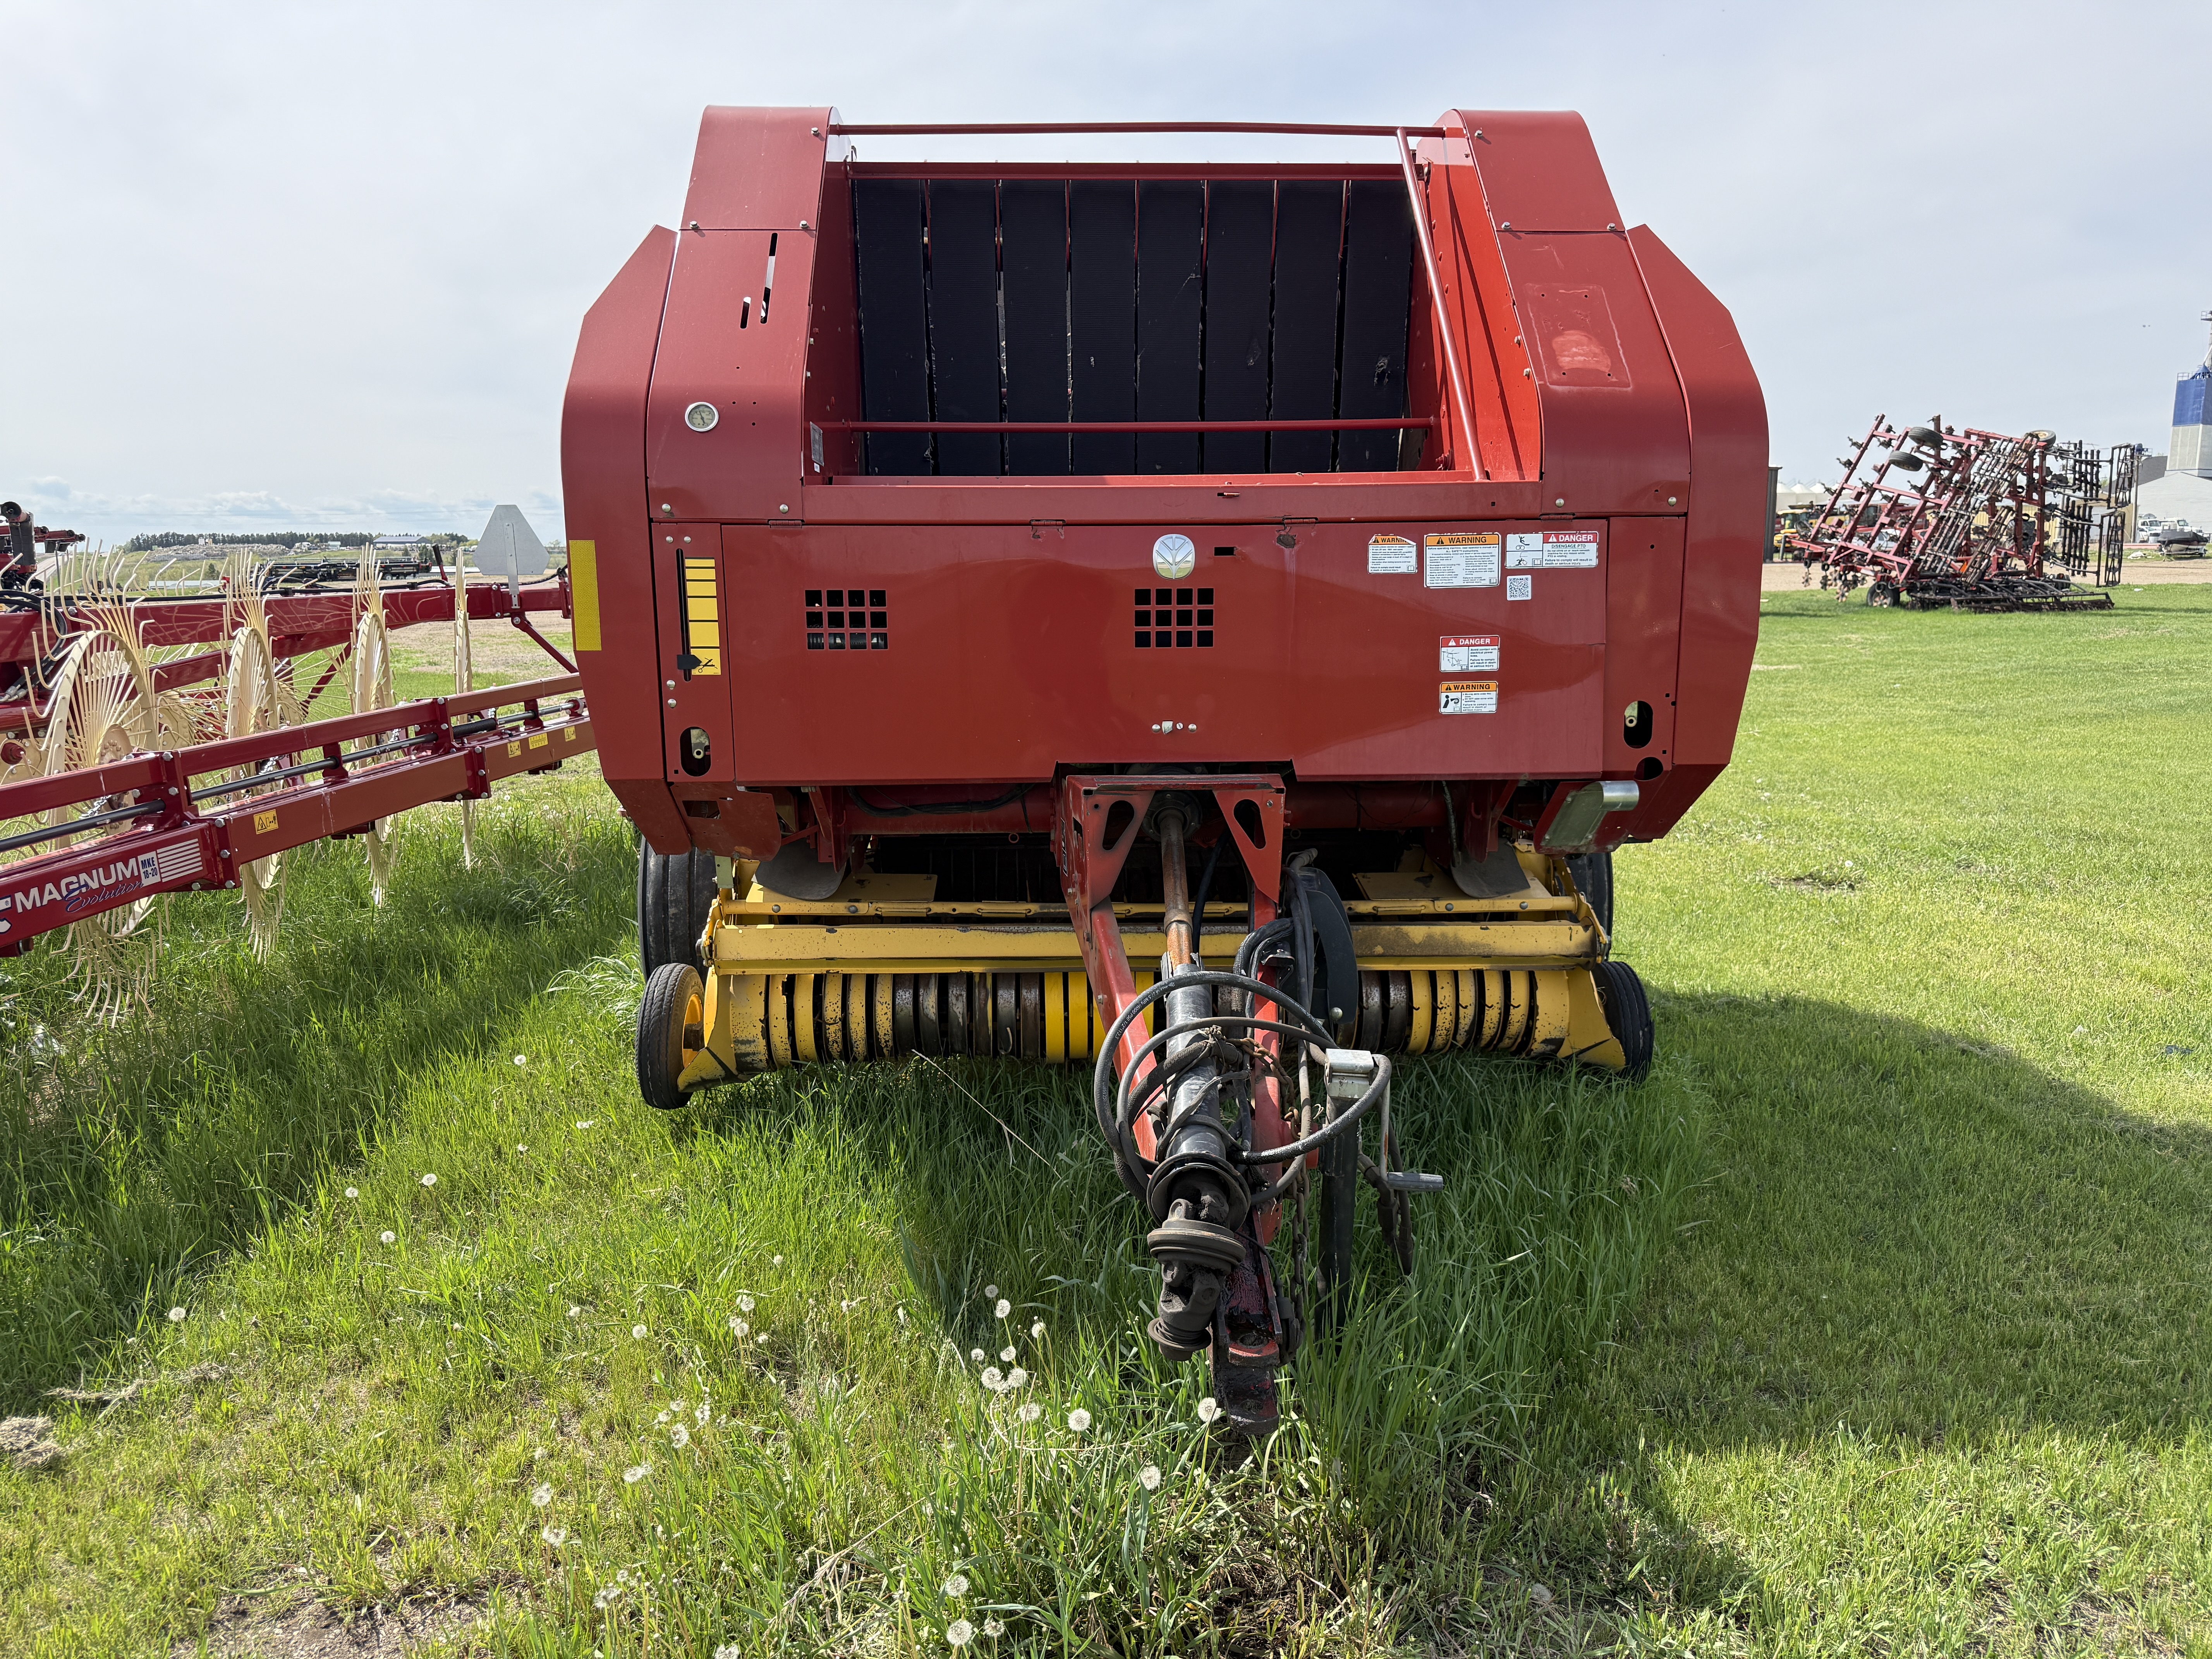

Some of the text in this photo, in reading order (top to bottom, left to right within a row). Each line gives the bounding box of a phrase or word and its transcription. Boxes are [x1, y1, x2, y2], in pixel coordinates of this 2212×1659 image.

[141, 857, 155, 870] MKE
[142, 867, 158, 879] 18-20
[14, 857, 139, 913] MAGNUM
[64, 881, 145, 913] Evolution
